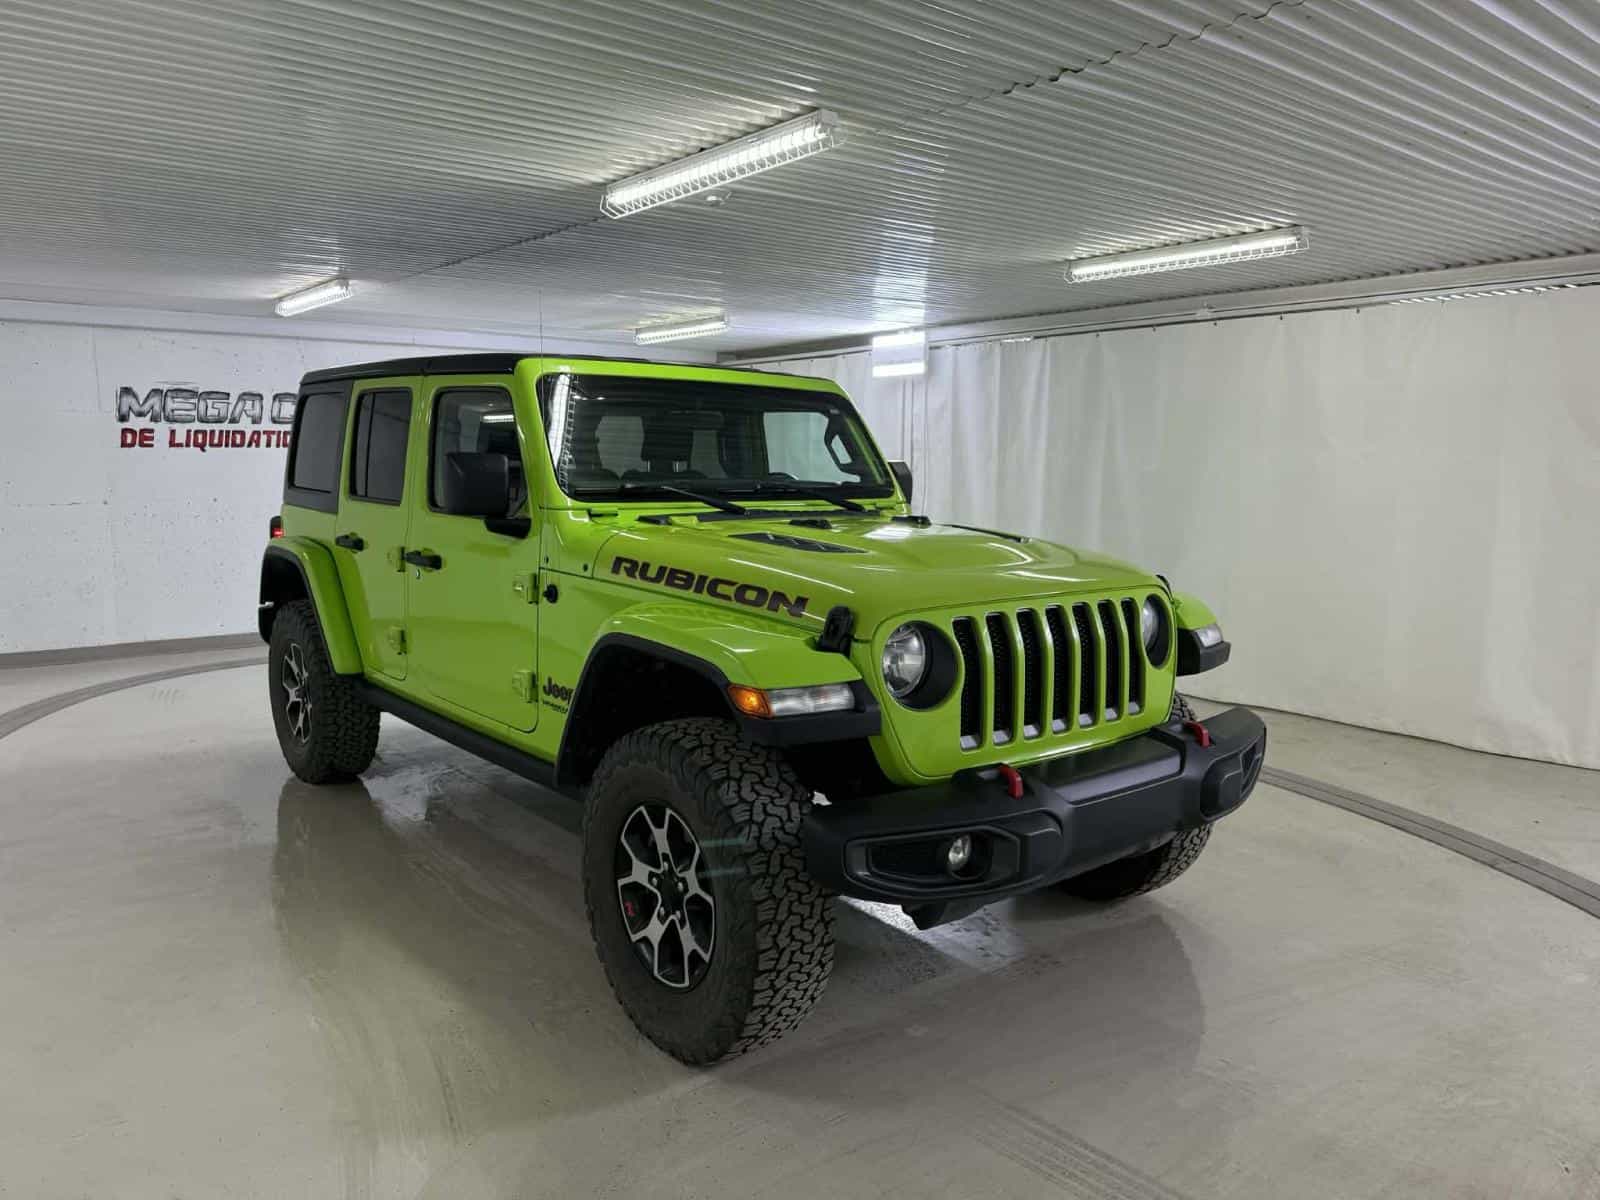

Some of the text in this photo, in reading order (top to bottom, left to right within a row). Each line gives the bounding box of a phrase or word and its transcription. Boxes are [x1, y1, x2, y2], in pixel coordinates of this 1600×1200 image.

[116, 386, 263, 424] MEGA
[120, 428, 155, 448] DE
[611, 556, 809, 618] RUBICON
